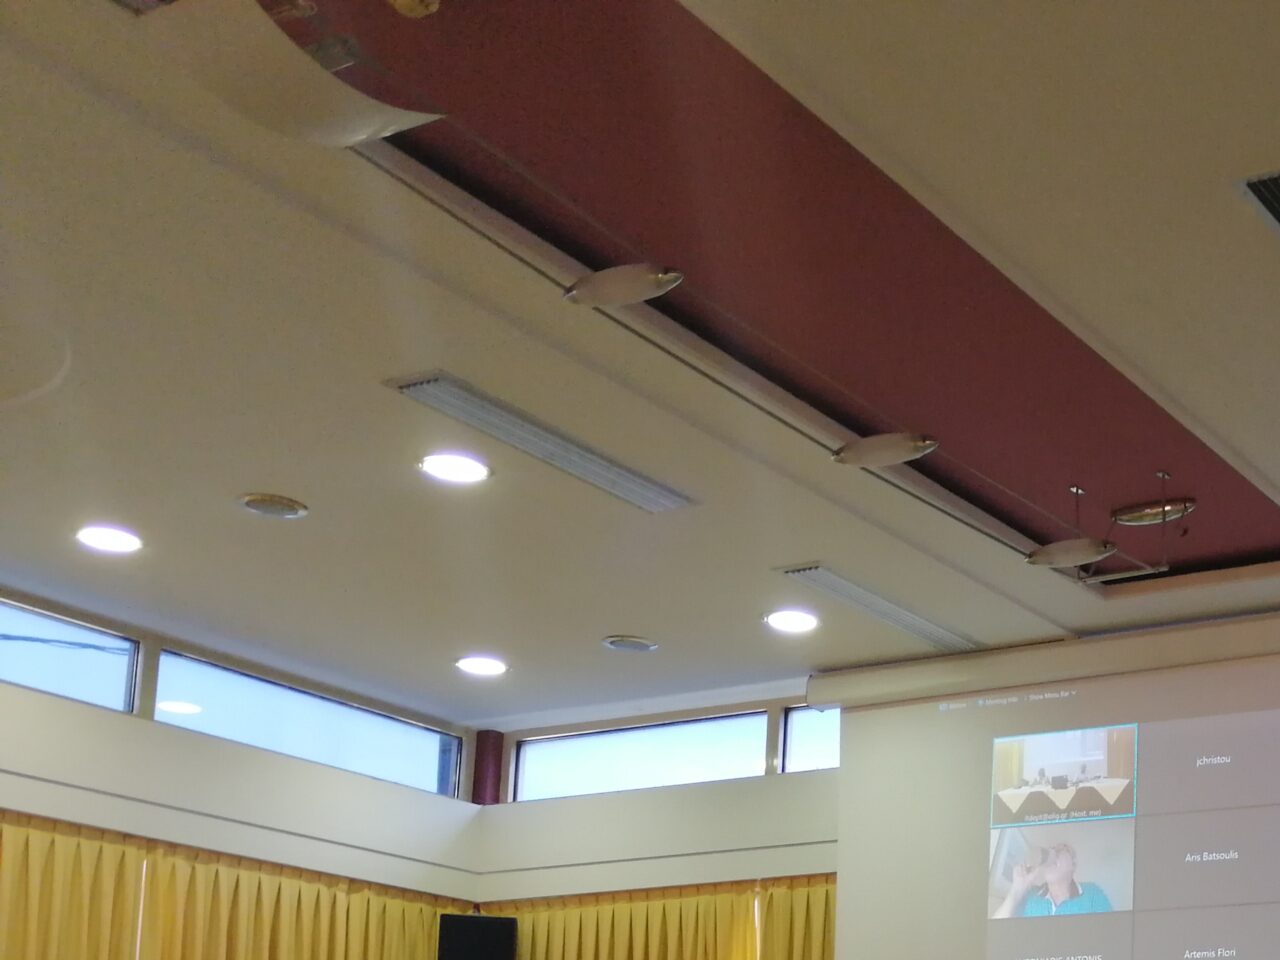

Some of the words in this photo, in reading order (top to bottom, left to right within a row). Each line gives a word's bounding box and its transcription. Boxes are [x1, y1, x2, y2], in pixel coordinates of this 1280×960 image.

[1196, 754, 1231, 767] jchristou
[1185, 851, 1201, 863] Aris
[1202, 849, 1239, 861] Batsoulis
[1184, 949, 1216, 960] Artemis
[1218, 947, 1236, 958] Flori
